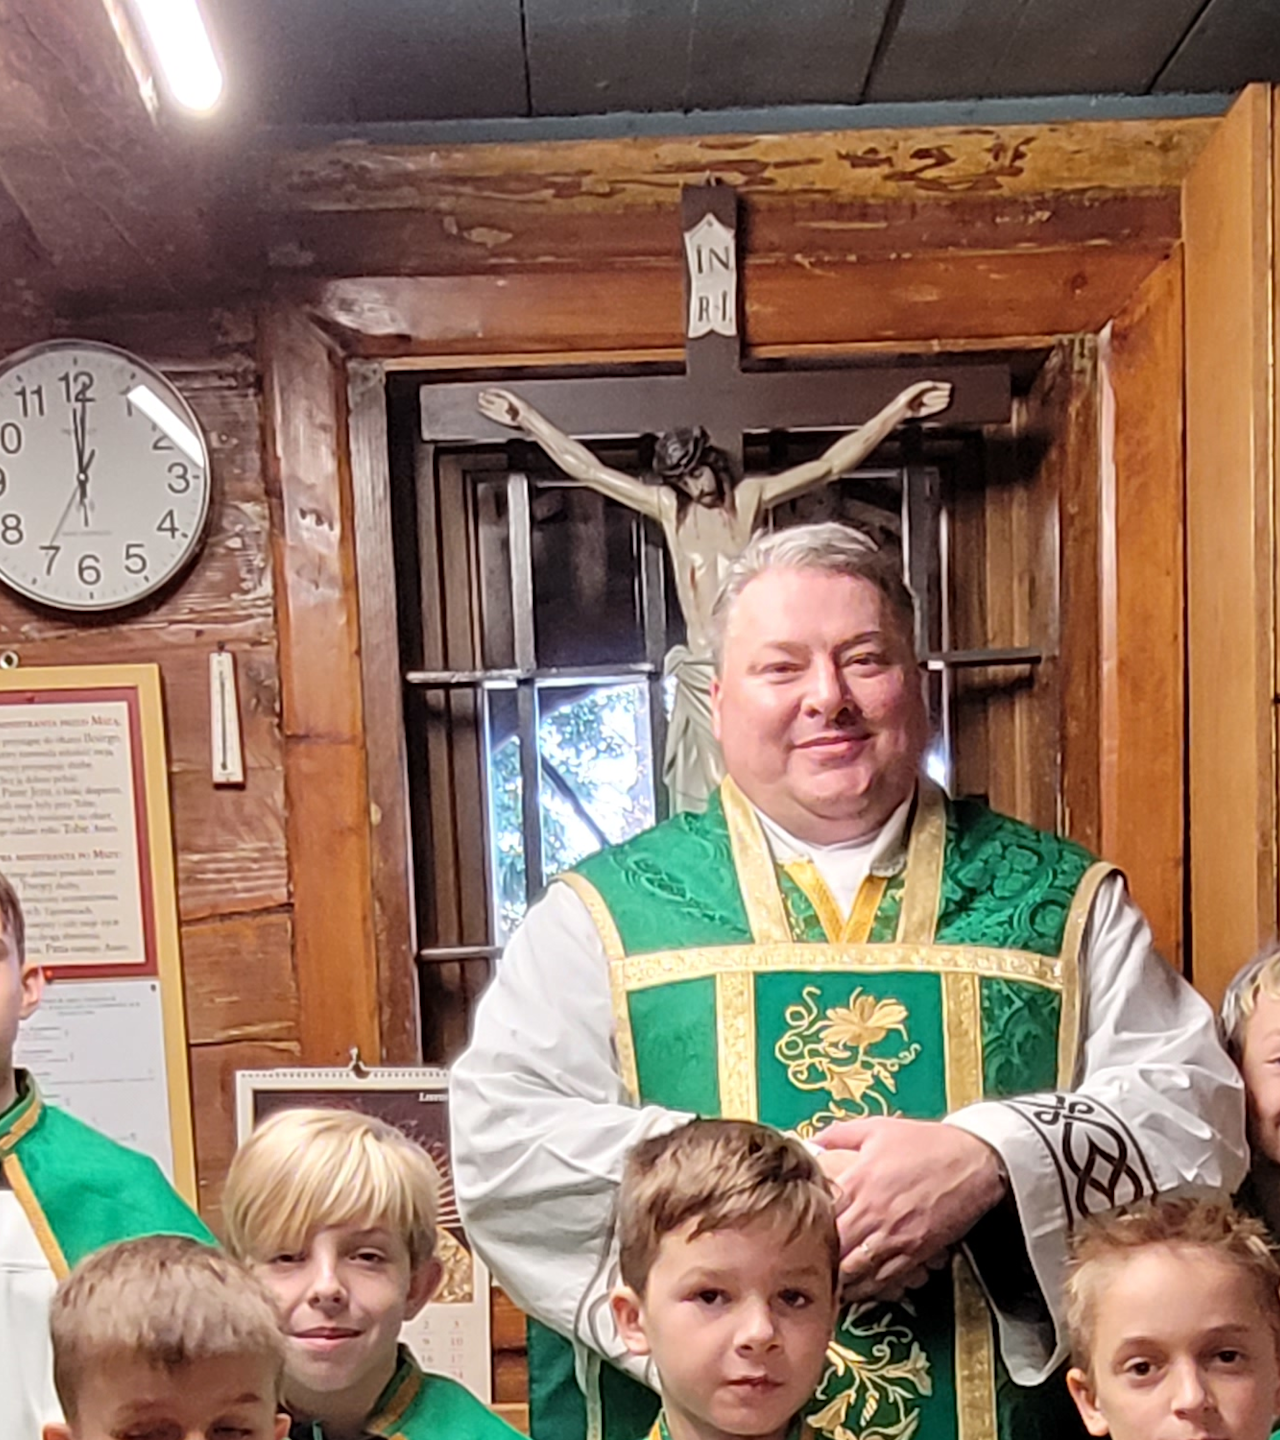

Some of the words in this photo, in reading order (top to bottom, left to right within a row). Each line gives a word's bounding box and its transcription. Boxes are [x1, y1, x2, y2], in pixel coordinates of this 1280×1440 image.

[696, 244, 731, 275] IN
[15, 385, 44, 417] 11
[58, 371, 96, 403] 12
[167, 462, 190, 494] 3
[1, 514, 24, 545] 8
[156, 509, 179, 540] 4
[39, 545, 61, 576] 7
[78, 554, 101, 585] 6
[124, 543, 147, 574] 5
